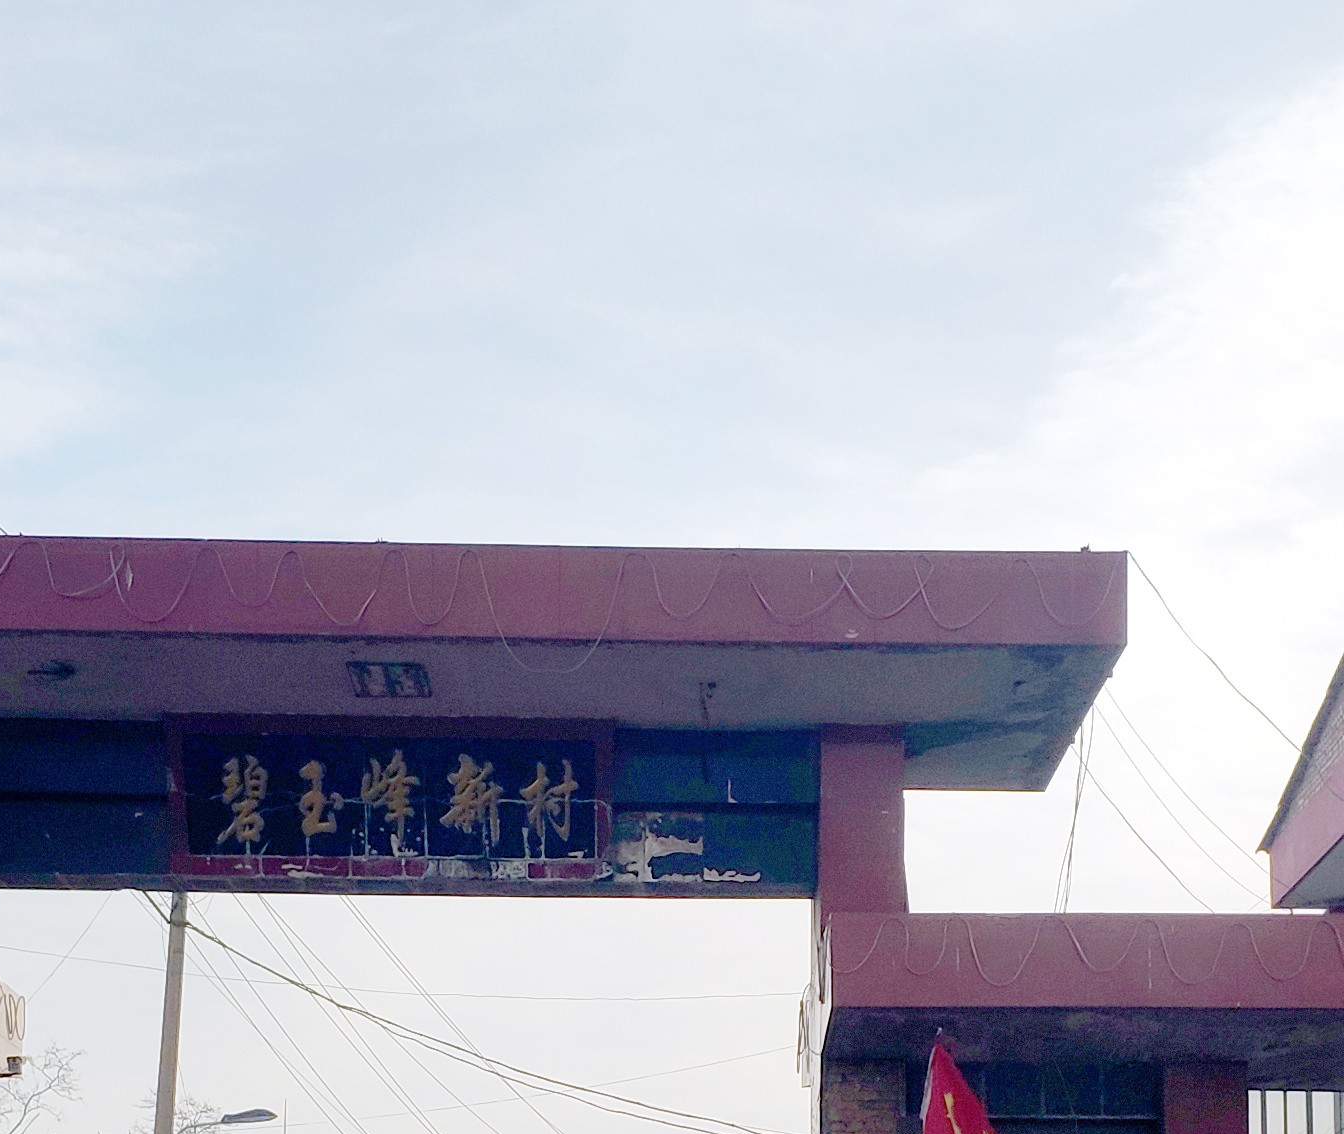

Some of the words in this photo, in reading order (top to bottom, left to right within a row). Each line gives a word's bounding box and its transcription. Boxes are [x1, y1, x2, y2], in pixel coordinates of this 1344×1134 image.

[217, 749, 579, 844] 碧玉峰新村
